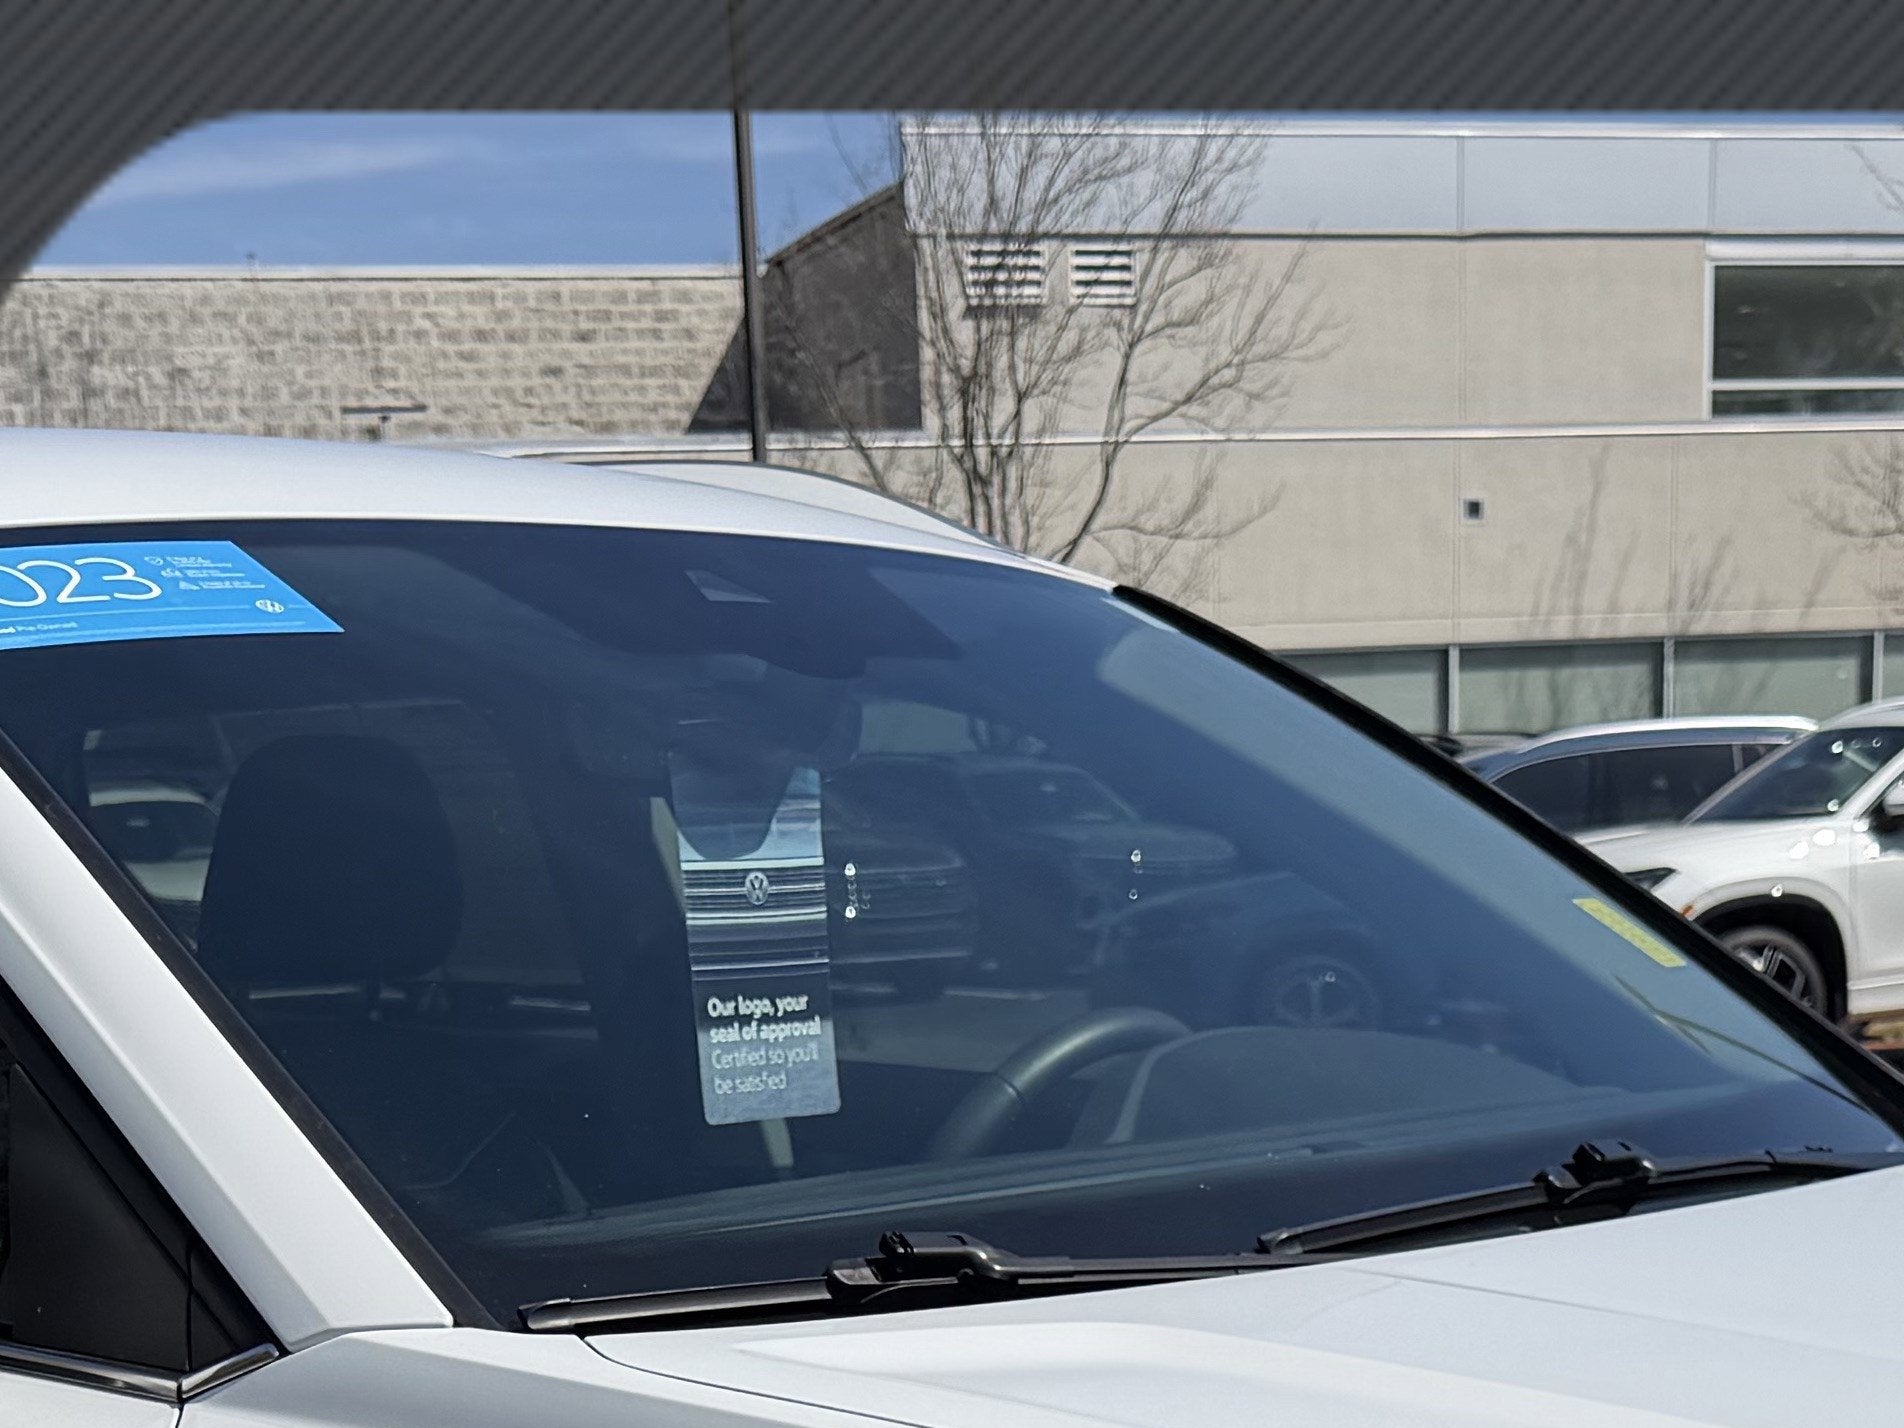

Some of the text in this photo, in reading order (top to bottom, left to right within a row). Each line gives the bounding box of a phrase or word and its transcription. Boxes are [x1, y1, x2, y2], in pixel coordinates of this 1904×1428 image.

[707, 994, 809, 1019] Our logo, your
[710, 1014, 822, 1043] seal of approval
[767, 1049, 786, 1065] so
[714, 1077, 733, 1094] be
